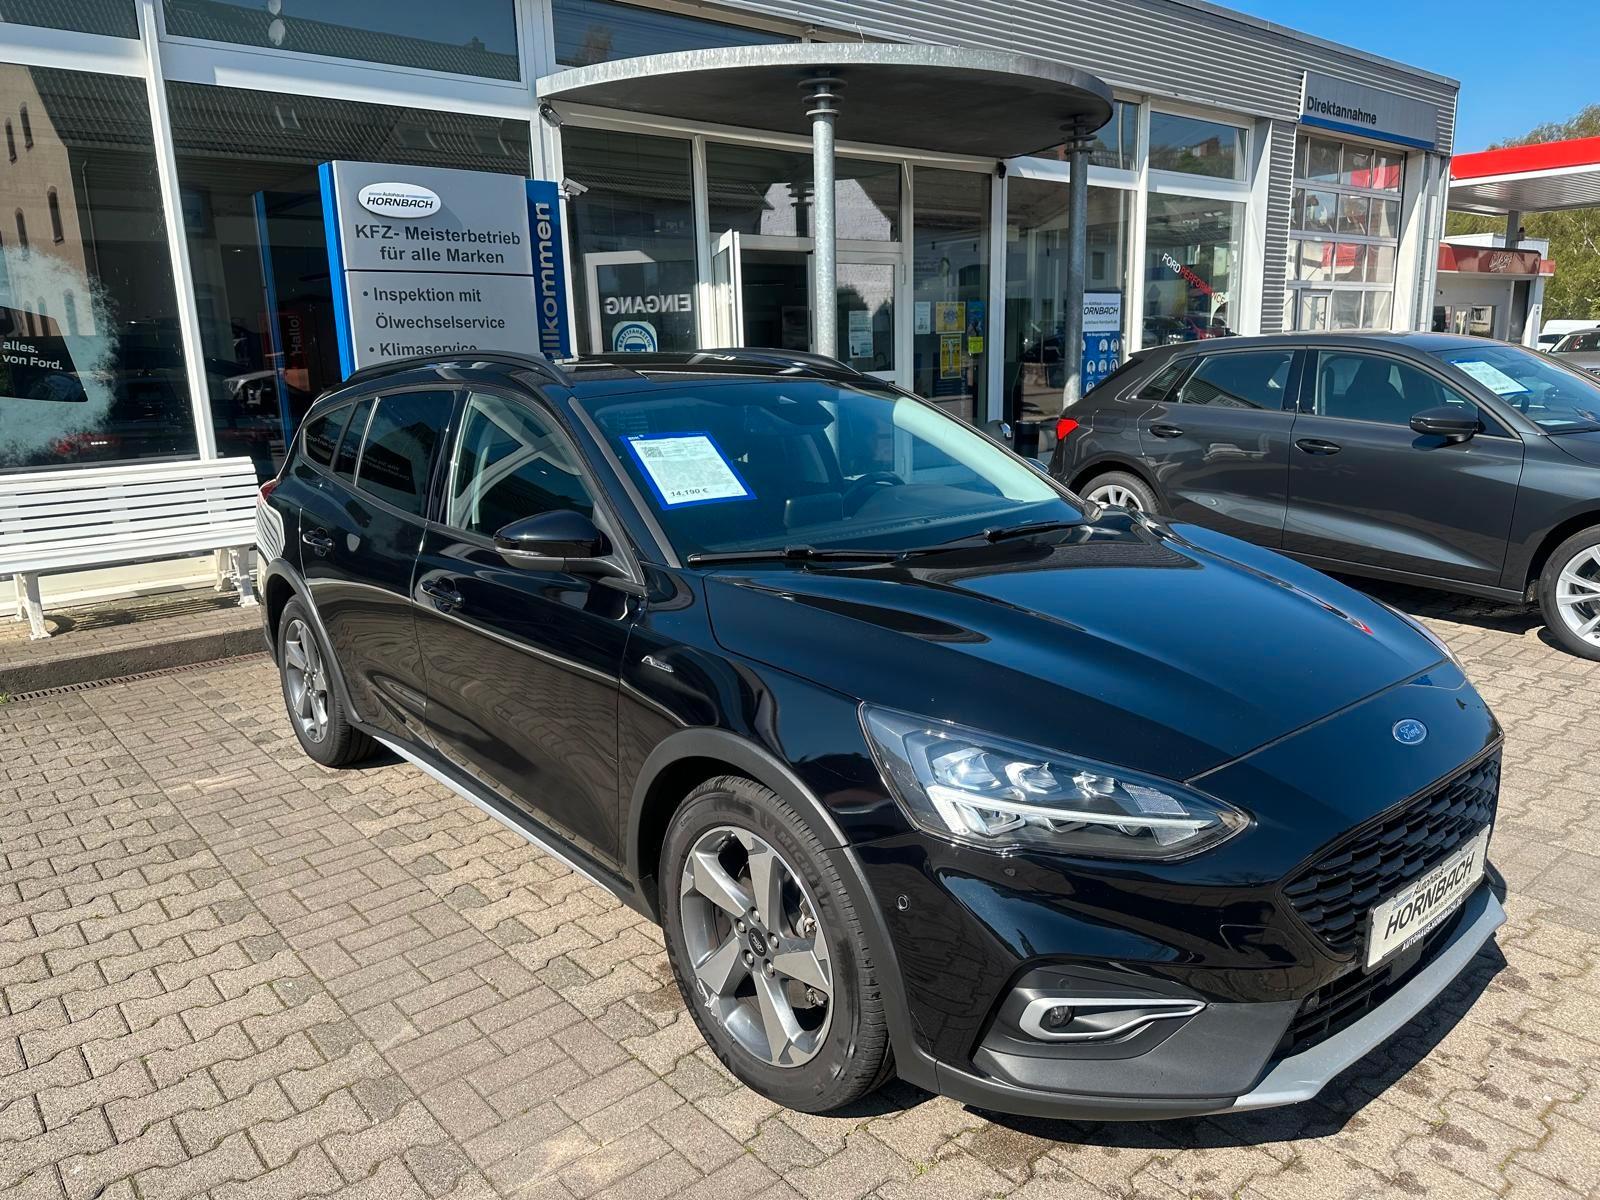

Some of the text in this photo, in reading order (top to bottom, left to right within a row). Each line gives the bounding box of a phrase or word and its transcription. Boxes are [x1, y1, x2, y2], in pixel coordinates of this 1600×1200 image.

[1307, 95, 1377, 125] Direktannahme
[366, 197, 434, 209] HORNBACH
[355, 224, 521, 245] KFZ- Meisterbetrieb
[380, 246, 505, 264] für alle Marken
[1161, 252, 1181, 274] FORD
[535, 202, 561, 355] illkommen
[374, 287, 482, 304] Inspektion mit
[1083, 306, 1119, 315] ORNBACH
[375, 312, 506, 329] Ölwechselservice
[2, 340, 39, 354] alles.
[2, 354, 63, 370] von Ford.
[1412, 867, 1445, 897] Autohaus
[1384, 851, 1475, 940] HORNBACH
